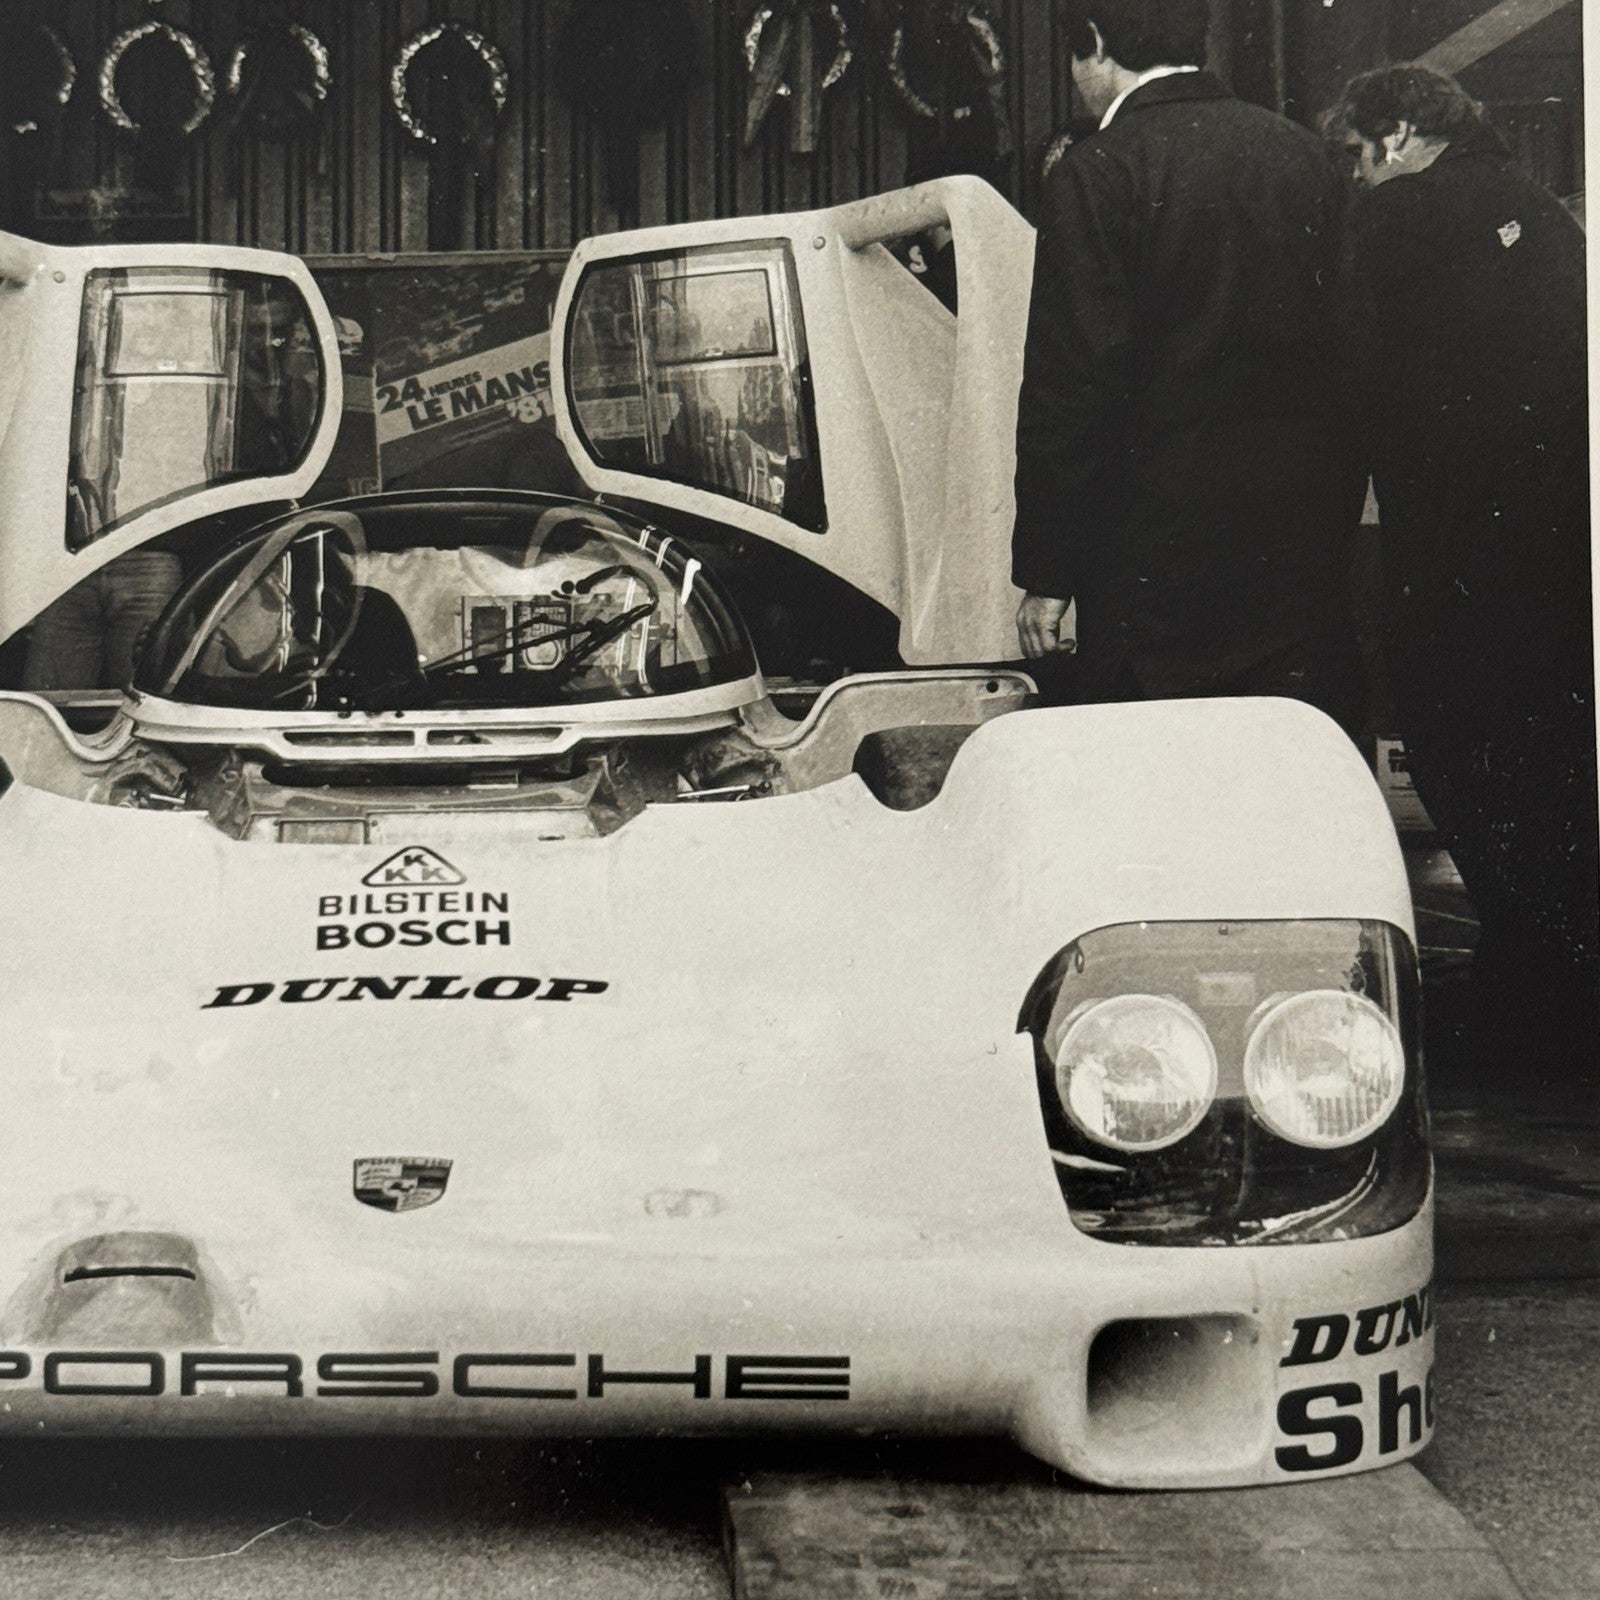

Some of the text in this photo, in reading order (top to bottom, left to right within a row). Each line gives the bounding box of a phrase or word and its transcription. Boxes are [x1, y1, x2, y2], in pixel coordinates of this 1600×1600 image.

[376, 371, 482, 415] 24 HEURES
[406, 360, 551, 431] LE MANS
[318, 891, 509, 917] BILSTEIN
[316, 919, 510, 951] BOSCH
[200, 975, 610, 1010] DUNLOP
[0, 1351, 850, 1400] ORSCHE
